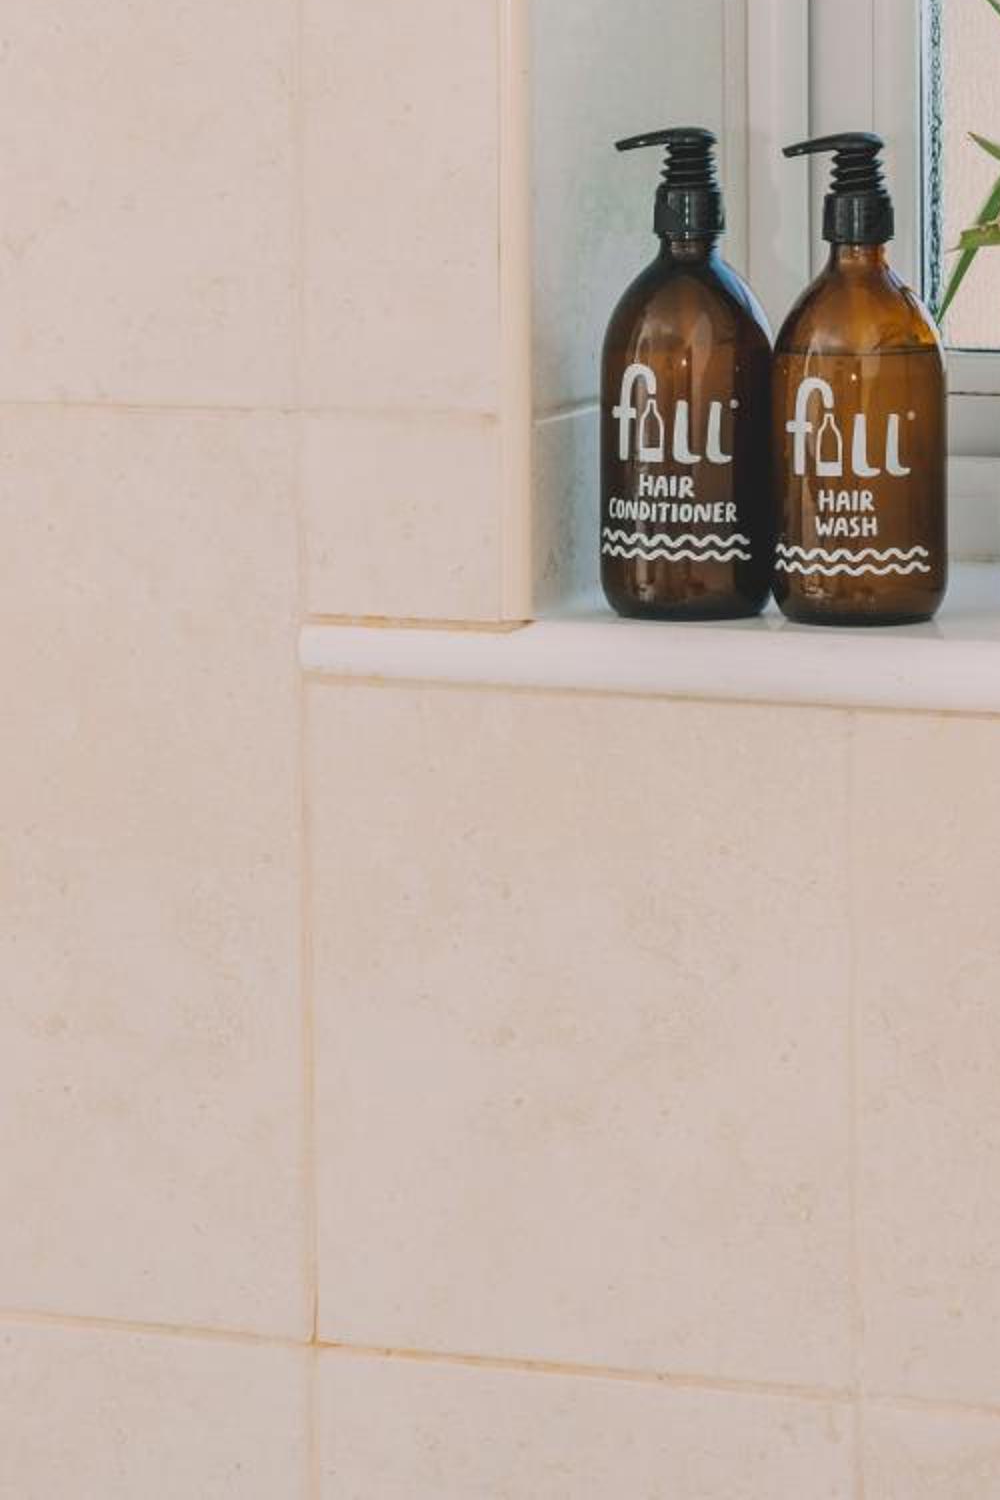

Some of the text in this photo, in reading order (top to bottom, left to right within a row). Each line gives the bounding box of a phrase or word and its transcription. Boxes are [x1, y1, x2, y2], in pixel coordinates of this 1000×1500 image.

[638, 473, 695, 498] HAIR
[608, 497, 737, 523] CONDITIONER
[818, 489, 875, 512] HAIR
[814, 516, 878, 537] WASH
